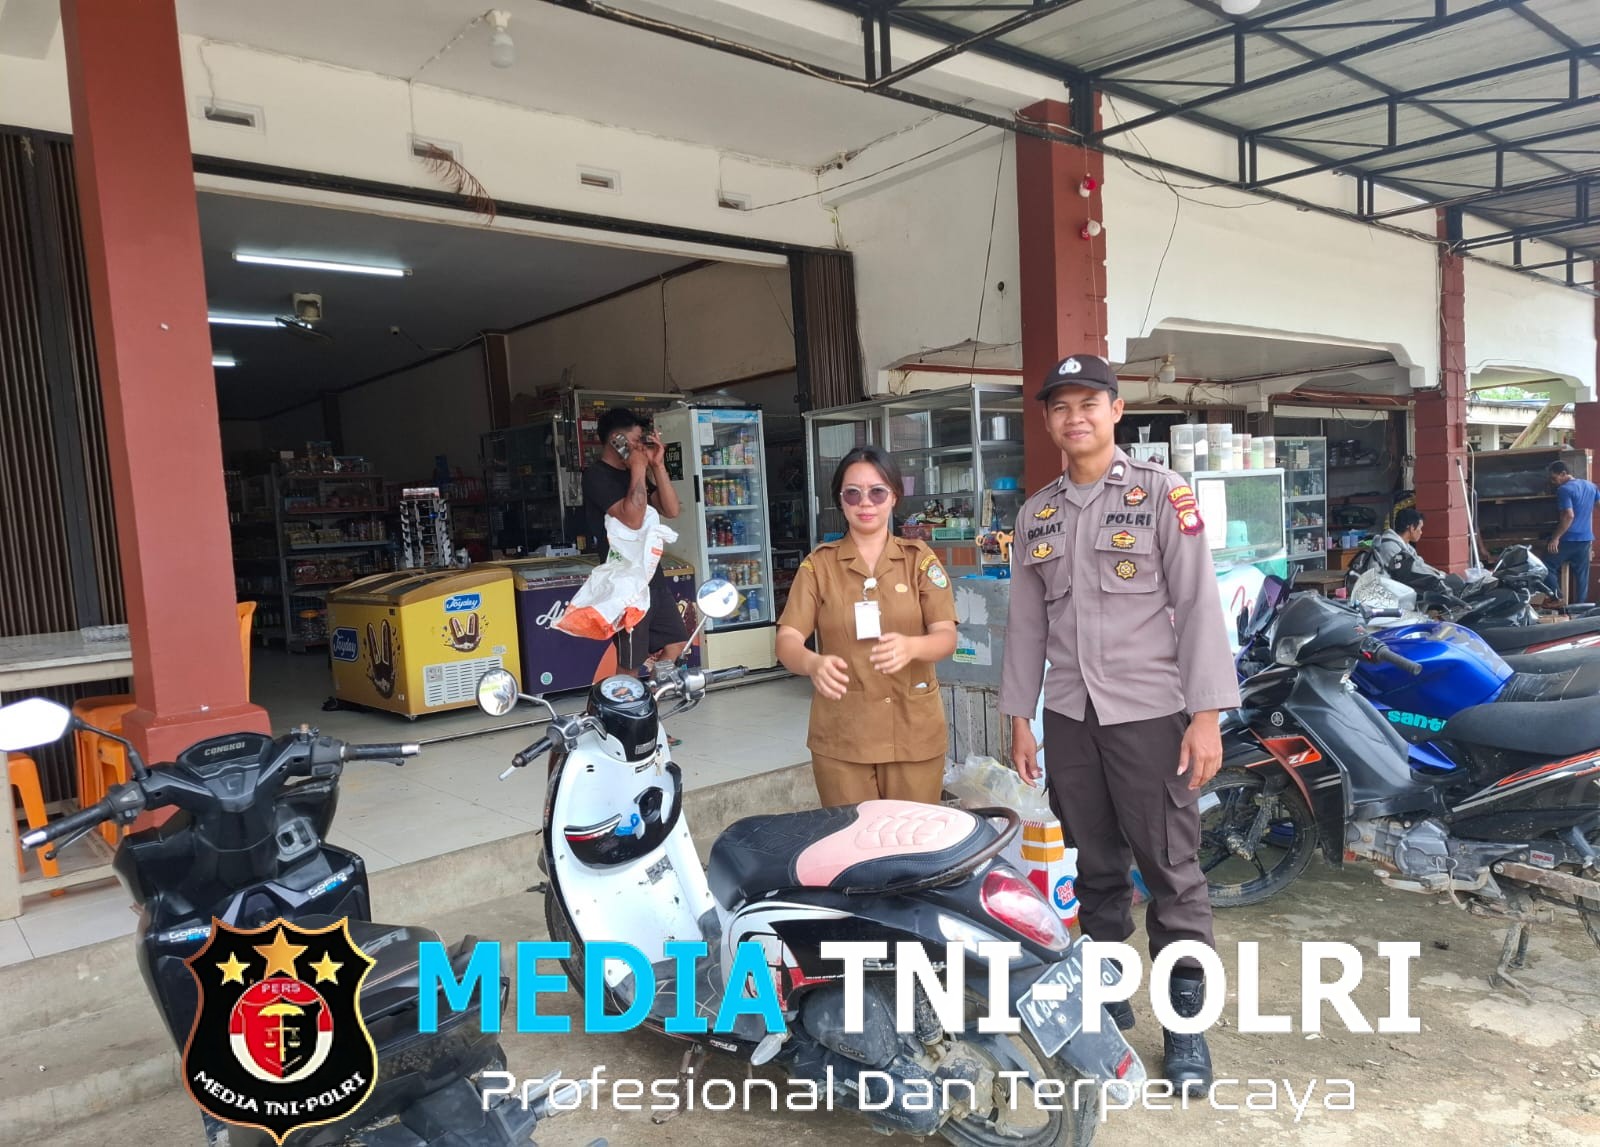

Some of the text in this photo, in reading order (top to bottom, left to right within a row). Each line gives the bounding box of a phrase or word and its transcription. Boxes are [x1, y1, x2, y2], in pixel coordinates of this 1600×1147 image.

[1105, 513, 1152, 527] POLRI
[1027, 521, 1063, 541] GOLIAT
[446, 598, 478, 611] Joyday
[333, 635, 358, 658] Joyday
[308, 872, 345, 896] GoPro
[169, 927, 211, 939] GoPro
